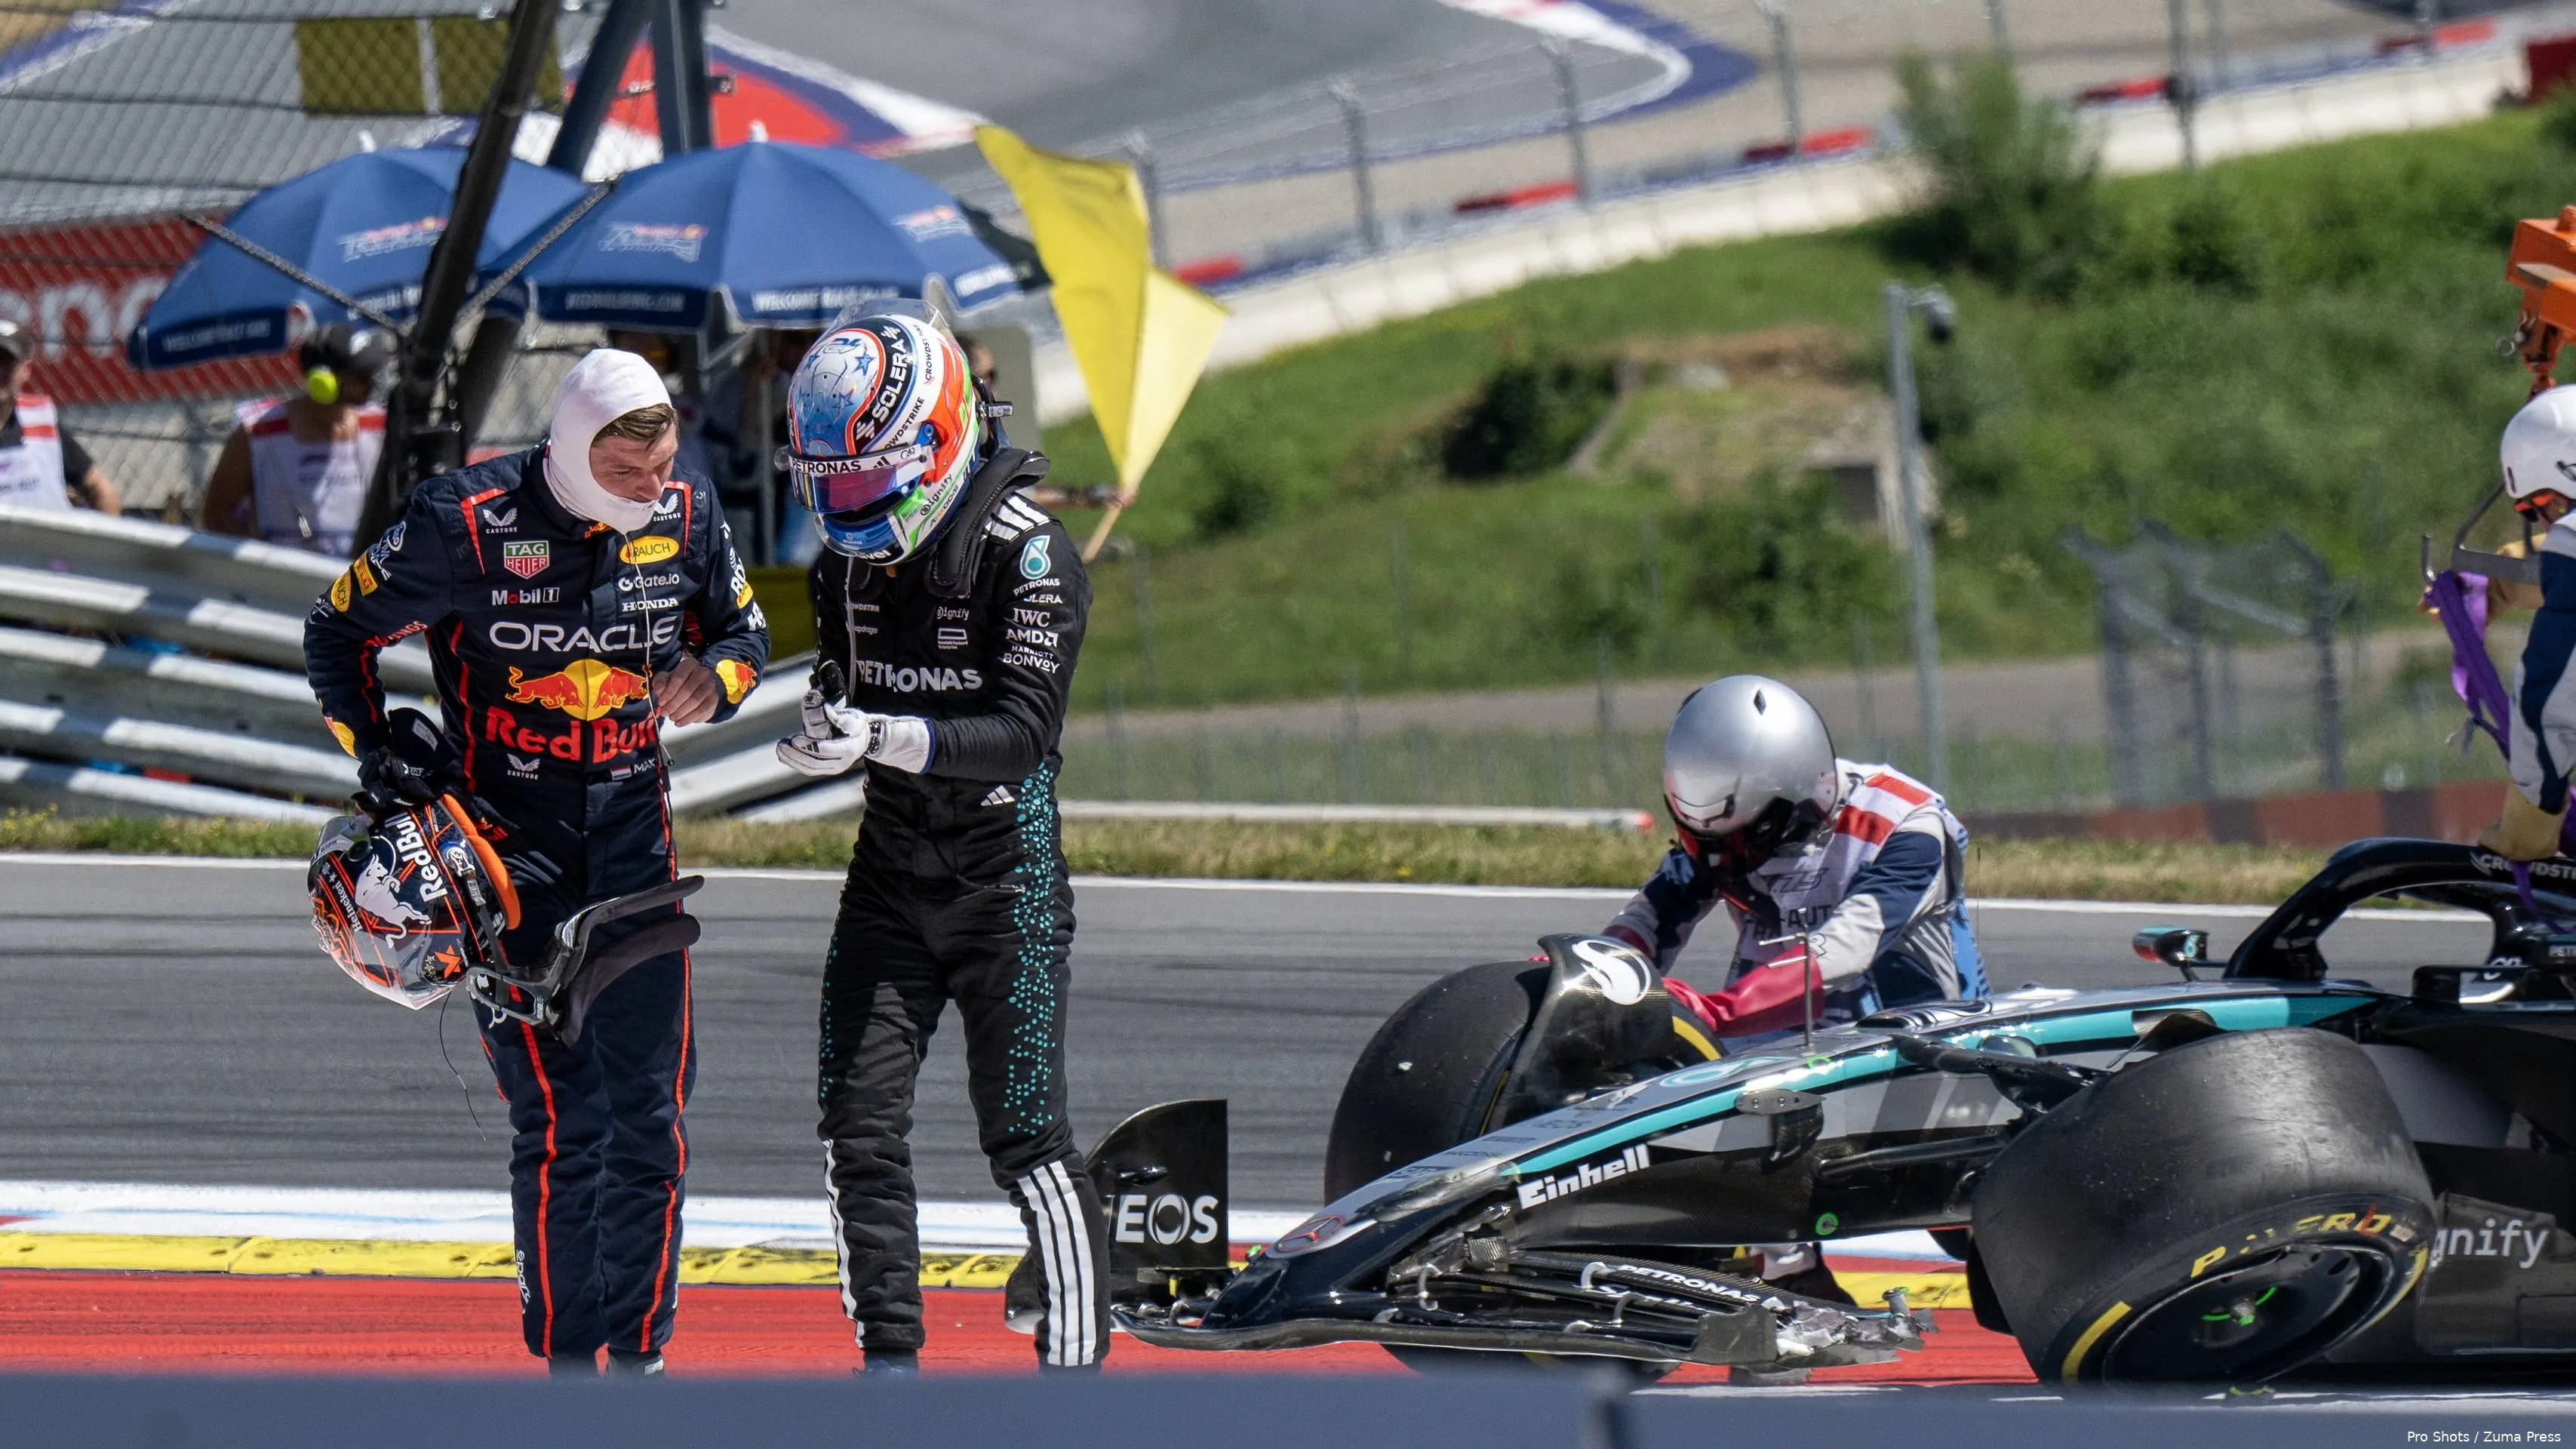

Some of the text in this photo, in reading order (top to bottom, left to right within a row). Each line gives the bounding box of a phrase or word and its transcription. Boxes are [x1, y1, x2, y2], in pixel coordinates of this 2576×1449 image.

[872, 339, 908, 423] SOLERA
[884, 396, 924, 451] OWDSTRIKE
[792, 458, 862, 473] PETRONAS
[653, 512, 681, 522] CASTORE
[507, 543, 545, 556] TAG
[632, 542, 671, 558] RAUCH
[506, 558, 546, 577] HEUER
[635, 573, 680, 589] Gate.io
[1013, 578, 1060, 596] PETRONAS
[492, 588, 541, 606] Mobil
[622, 598, 679, 612] HONDA
[1023, 594, 1062, 605] OLERA
[1013, 608, 1050, 627] IWC
[490, 615, 678, 654] ORACLE
[1006, 629, 1044, 644] AMD
[1012, 645, 1054, 659] MARRIOTT
[1003, 653, 1060, 674] BONVOY
[856, 660, 983, 693] PETRONAS
[485, 706, 662, 764] Red Bull
[507, 769, 539, 780] CASTORE
[634, 758, 656, 774] MAX
[334, 880, 363, 933] Heineken
[1517, 1143, 1651, 1209] Einhell
[1115, 1193, 1219, 1245] EOS
[2430, 1218, 2550, 1269] gnify
[2190, 1246, 2227, 1278] P
[1618, 1264, 1761, 1302] PETRONAS
